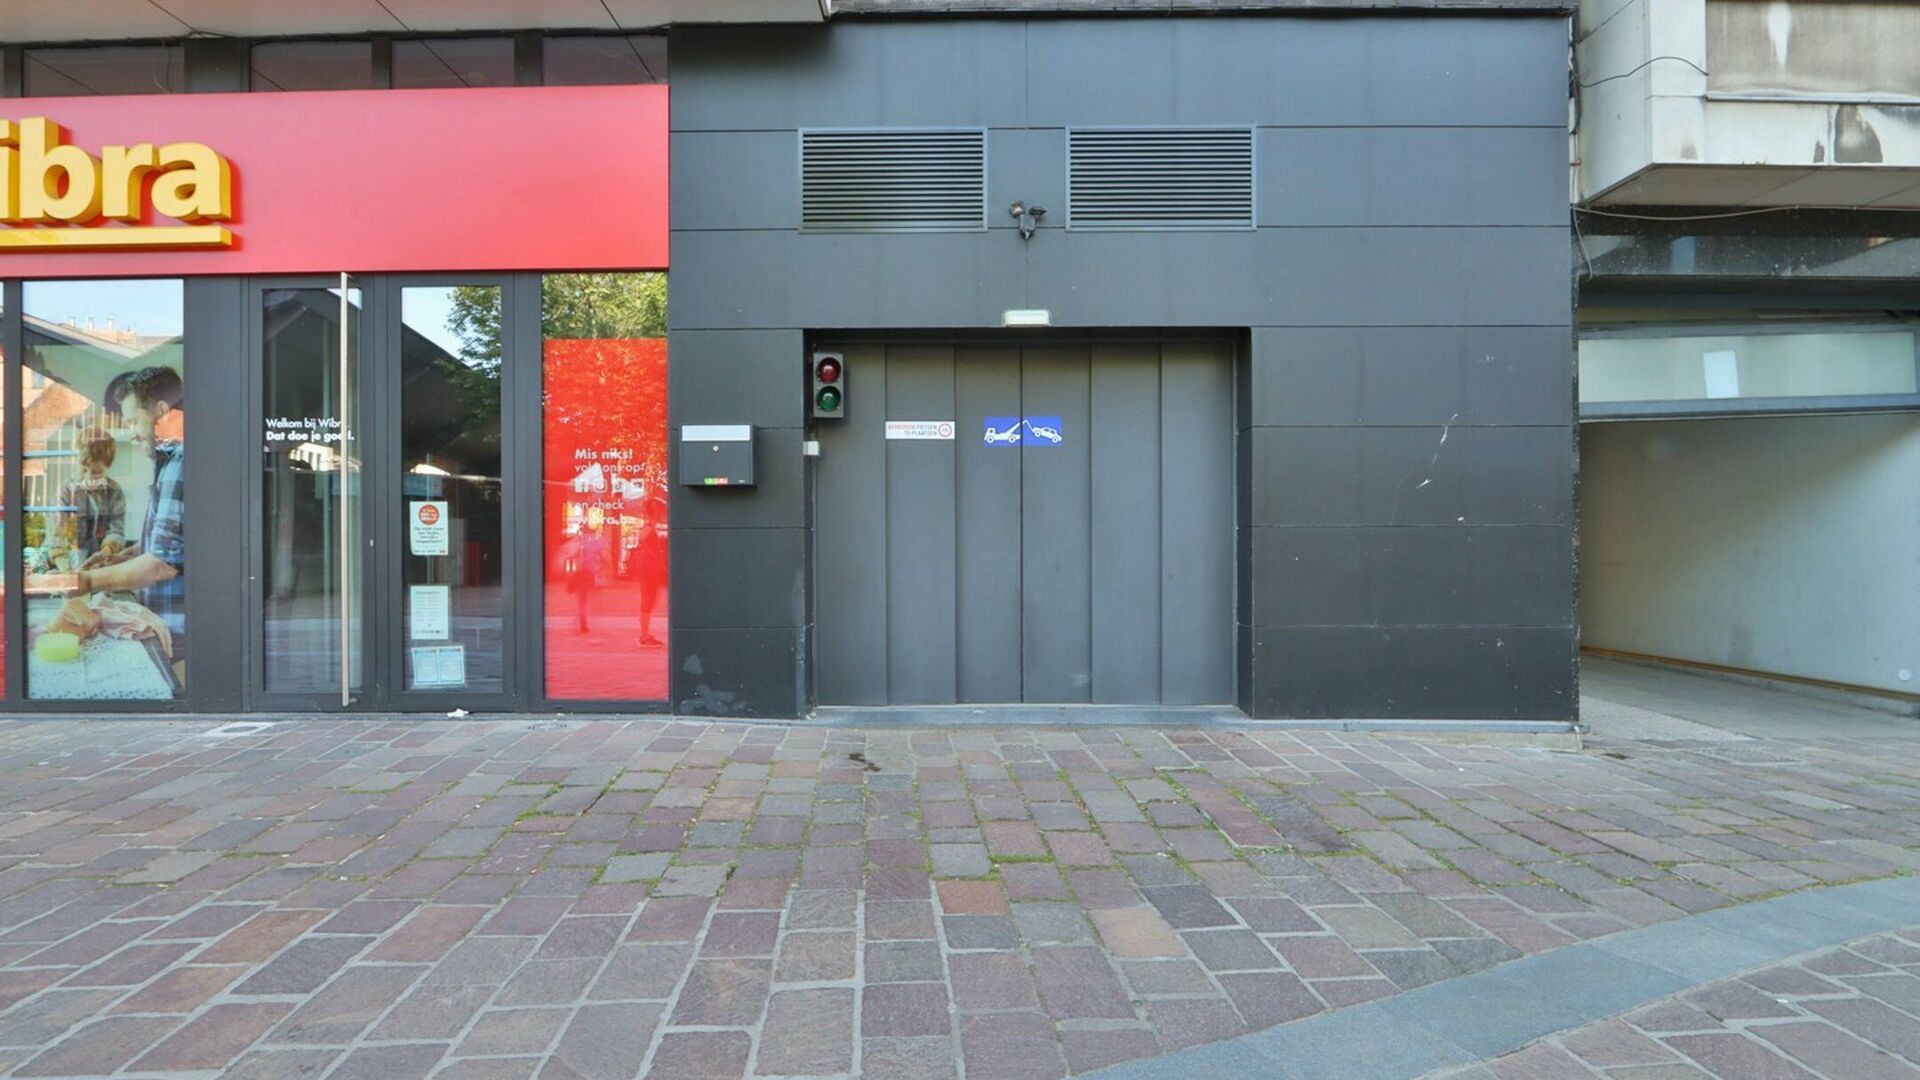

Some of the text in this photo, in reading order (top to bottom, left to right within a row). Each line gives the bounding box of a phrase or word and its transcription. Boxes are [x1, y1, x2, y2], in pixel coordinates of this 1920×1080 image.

[265, 417, 343, 430] Welkom bij Wibr
[266, 431, 286, 441] Dat
[287, 430, 309, 441] doe
[311, 430, 321, 443] je
[575, 448, 633, 459] Mis niks!
[574, 461, 601, 473] vol
[592, 499, 624, 510] check
[575, 511, 636, 525] wbra.be
